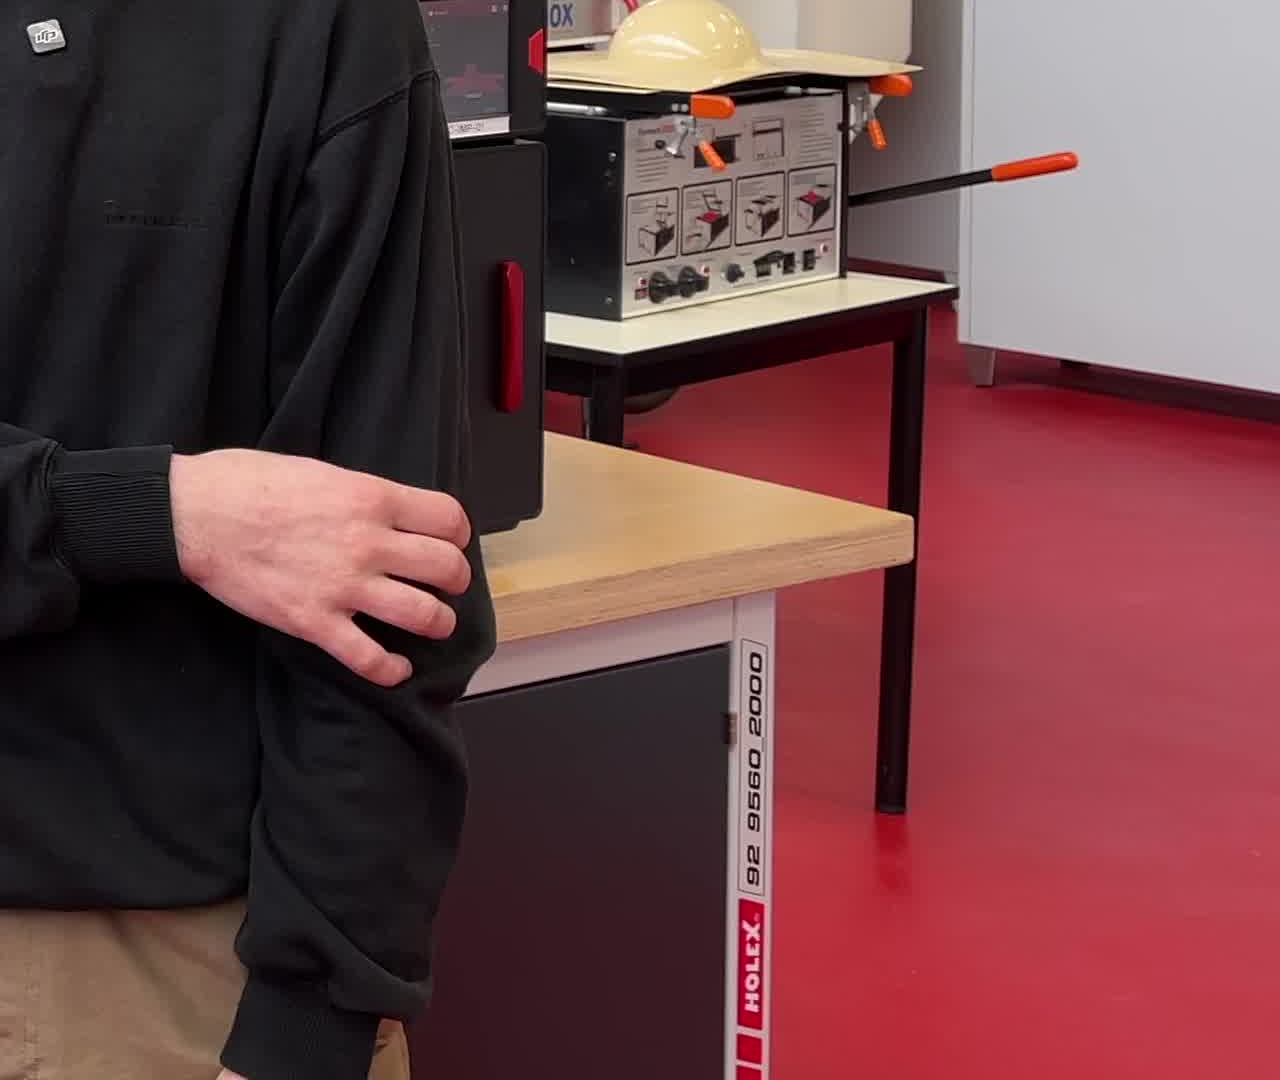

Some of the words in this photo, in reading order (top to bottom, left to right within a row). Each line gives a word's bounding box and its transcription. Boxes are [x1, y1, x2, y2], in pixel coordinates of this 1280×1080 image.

[748, 651, 764, 738] 2000
[747, 747, 762, 833] 9560
[746, 844, 761, 886] 92
[744, 920, 762, 1013] HOLEX
